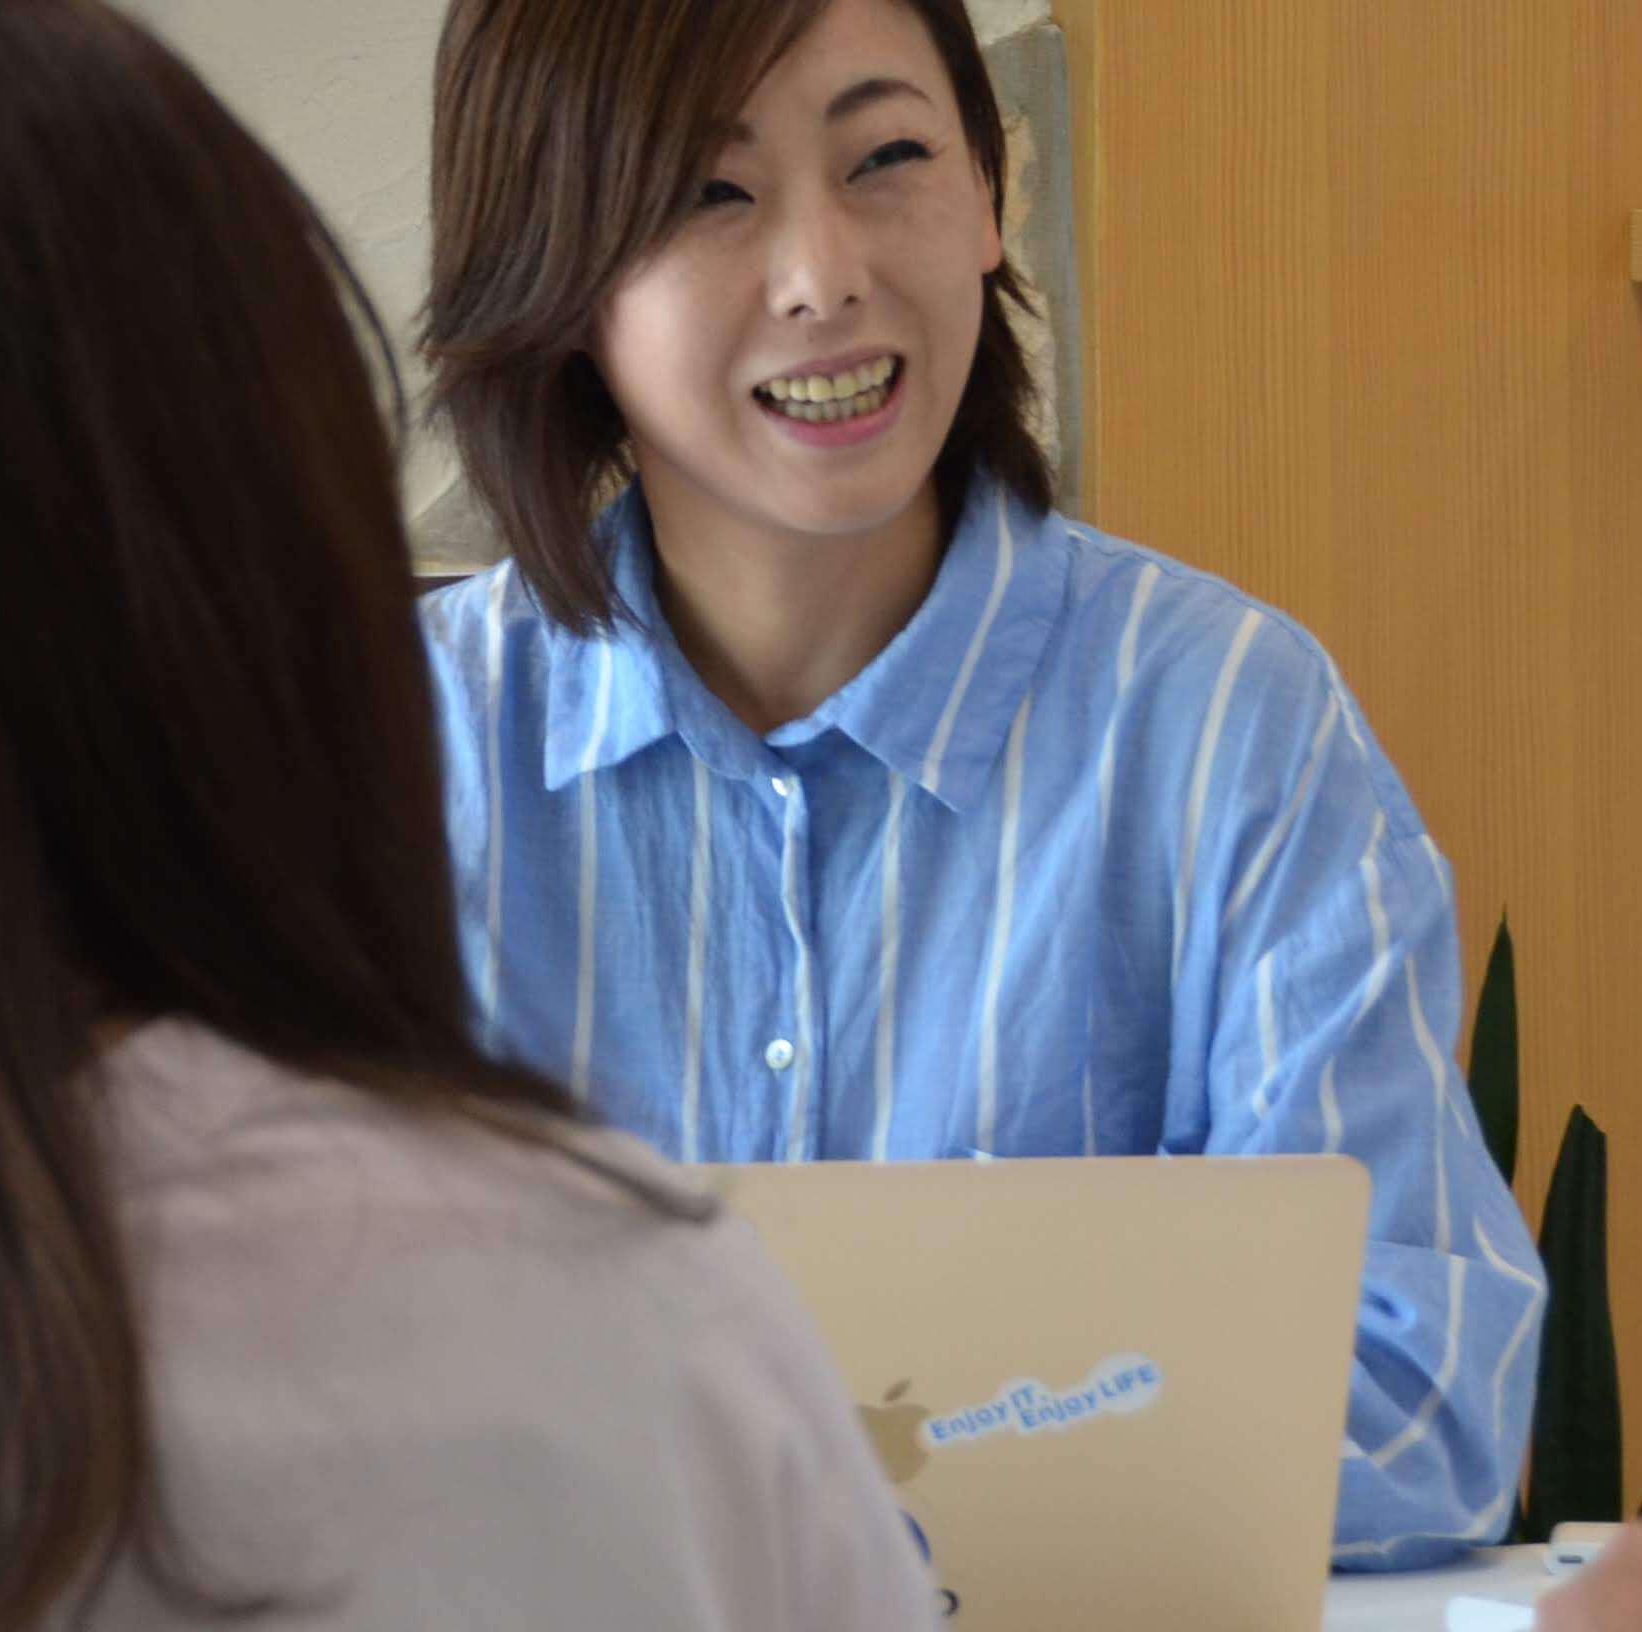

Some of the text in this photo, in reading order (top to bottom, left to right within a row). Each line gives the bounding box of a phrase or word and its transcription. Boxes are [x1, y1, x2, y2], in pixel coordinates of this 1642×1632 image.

[930, 1400, 1008, 1442] Enjoy
[1021, 1362, 1157, 1430] Enjoy LIFE
